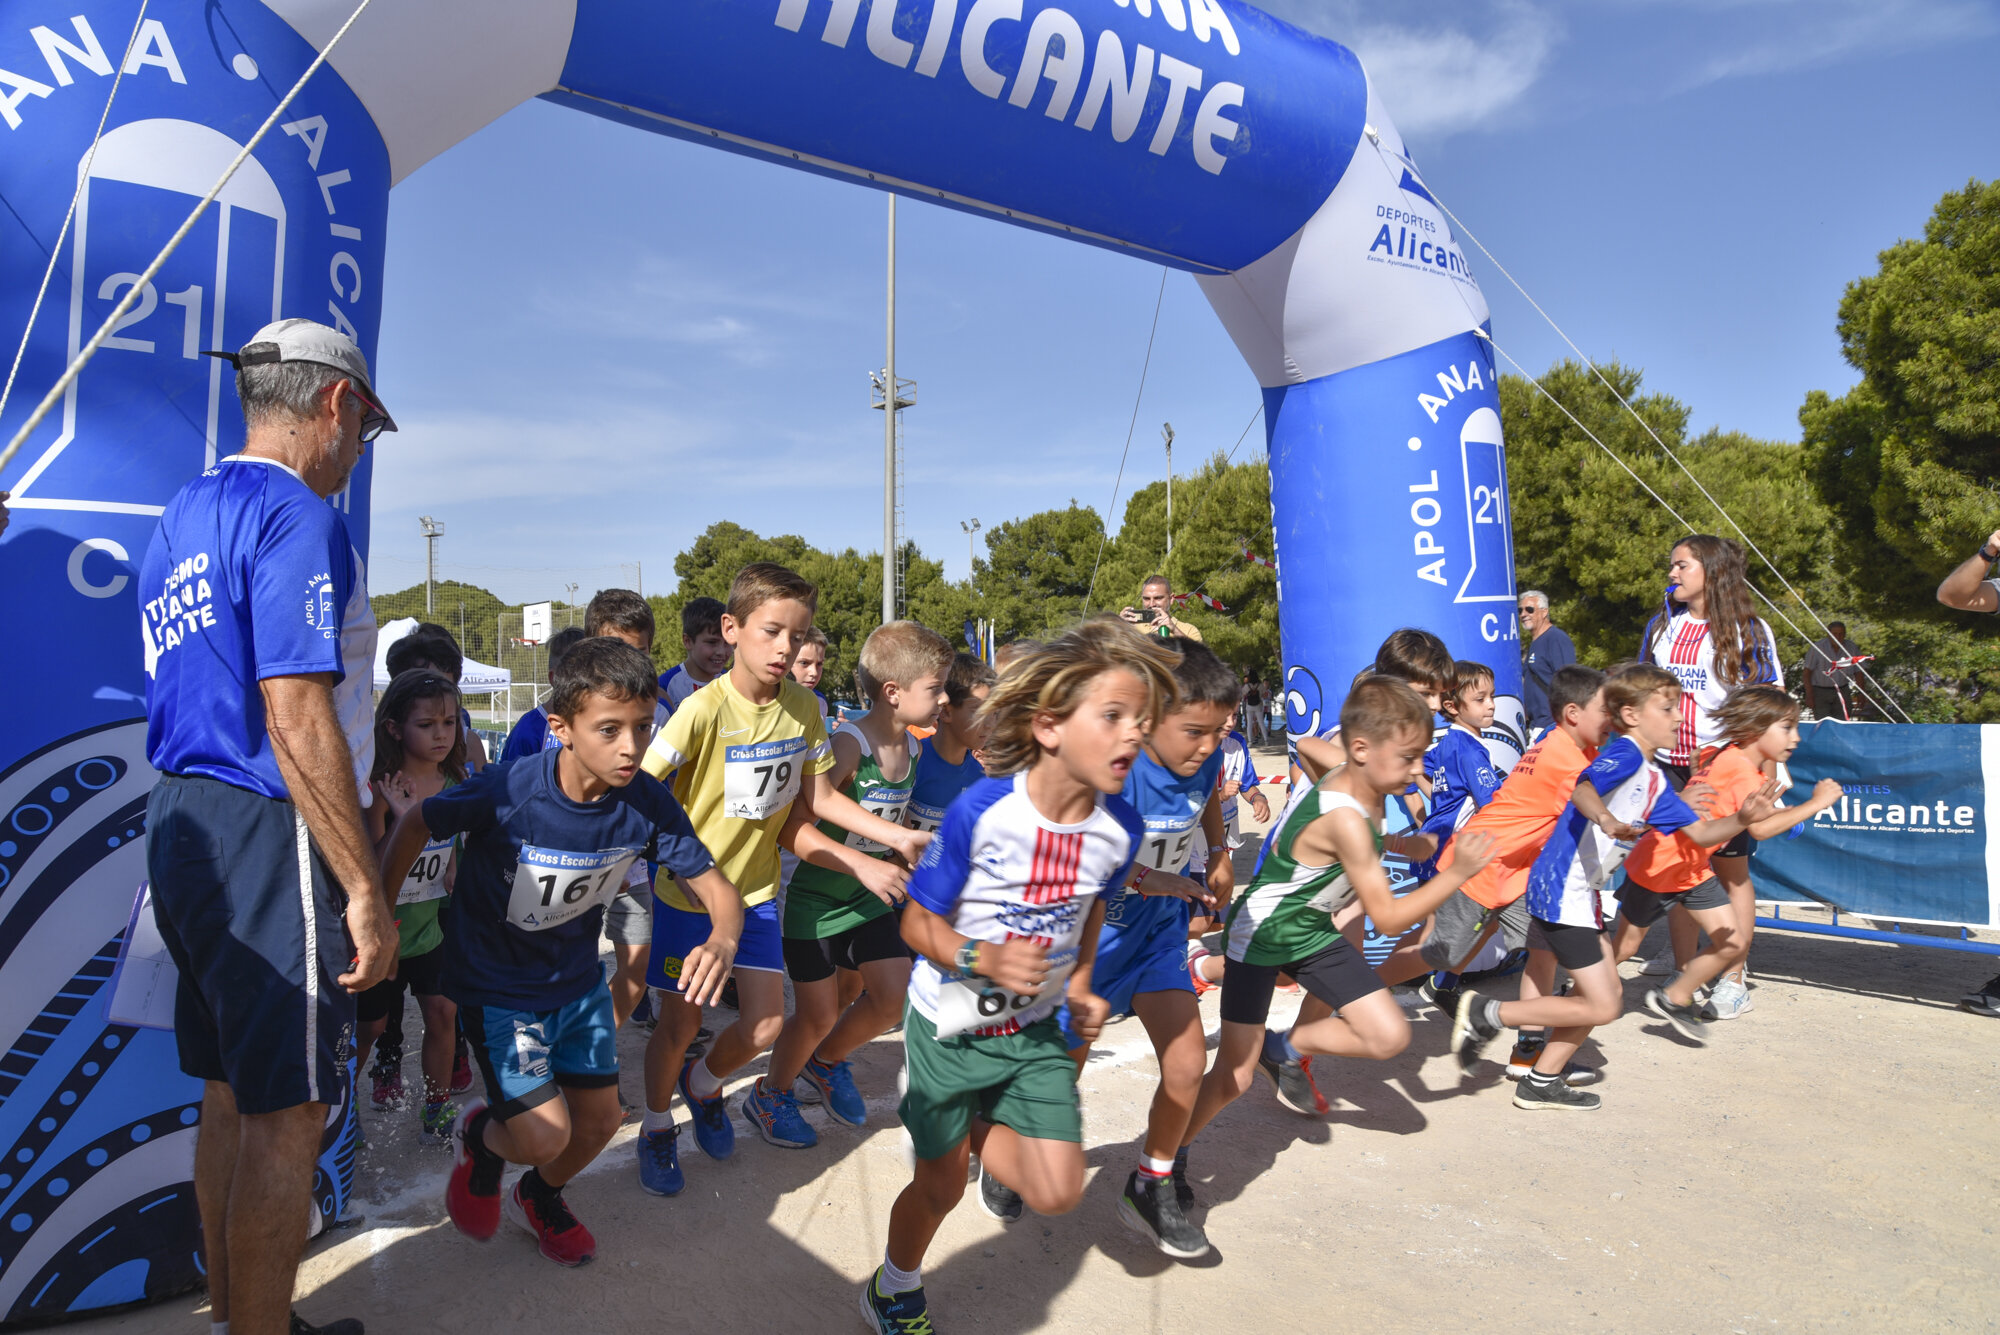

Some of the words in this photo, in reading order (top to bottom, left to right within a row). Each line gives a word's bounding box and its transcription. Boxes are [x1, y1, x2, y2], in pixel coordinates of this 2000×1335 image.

[1376, 205, 1436, 233] DEPORTES
[97, 271, 203, 361] 21
[1417, 361, 1484, 424] ANA
[1474, 485, 1503, 524] 21
[1409, 469, 1448, 586] APOL
[67, 538, 130, 599] C
[308, 573, 331, 588] ANA
[305, 598, 315, 626] APOL
[1680, 678, 1707, 691] ANTE
[731, 749, 755, 759] Cross
[755, 745, 783, 757] Escolar
[754, 761, 792, 798] 79
[1843, 784, 1891, 794] ORTES
[1814, 796, 1974, 826] Alicante
[408, 854, 440, 883] 40
[527, 849, 559, 865] Cross
[560, 855, 600, 867] Escolar
[538, 868, 614, 907] 161
[542, 908, 579, 923] Alicante
